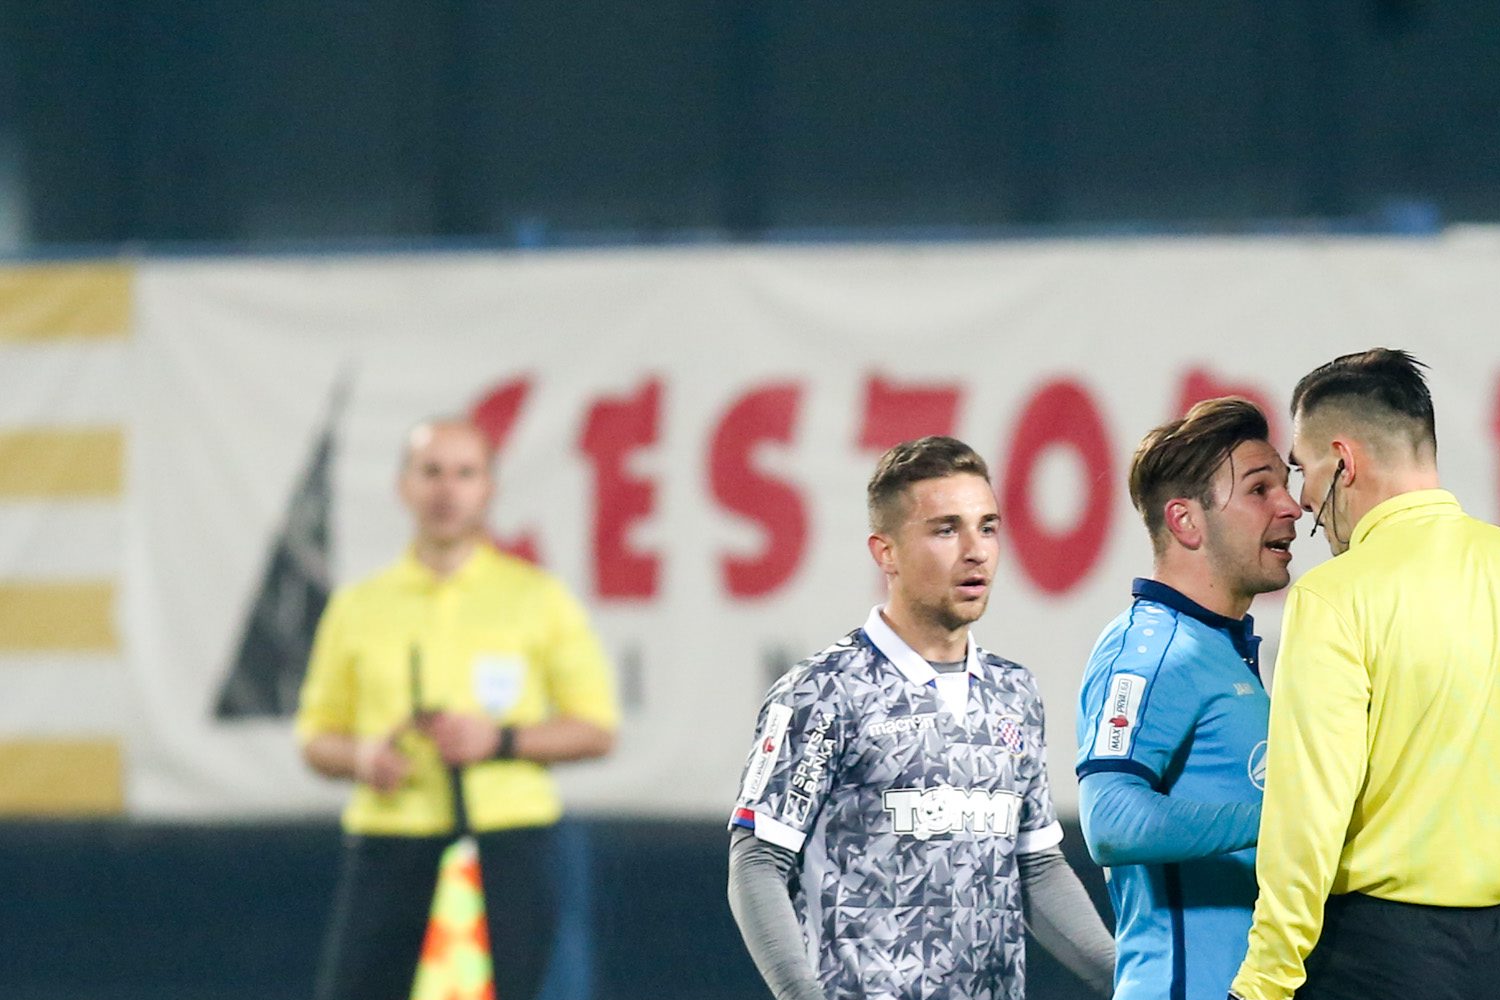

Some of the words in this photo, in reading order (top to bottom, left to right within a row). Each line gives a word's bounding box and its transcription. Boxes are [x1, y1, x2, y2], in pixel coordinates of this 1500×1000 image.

[792, 712, 836, 788] SPLITSKA
[803, 738, 837, 793] BANKA
[1111, 728, 1121, 750] MAX
